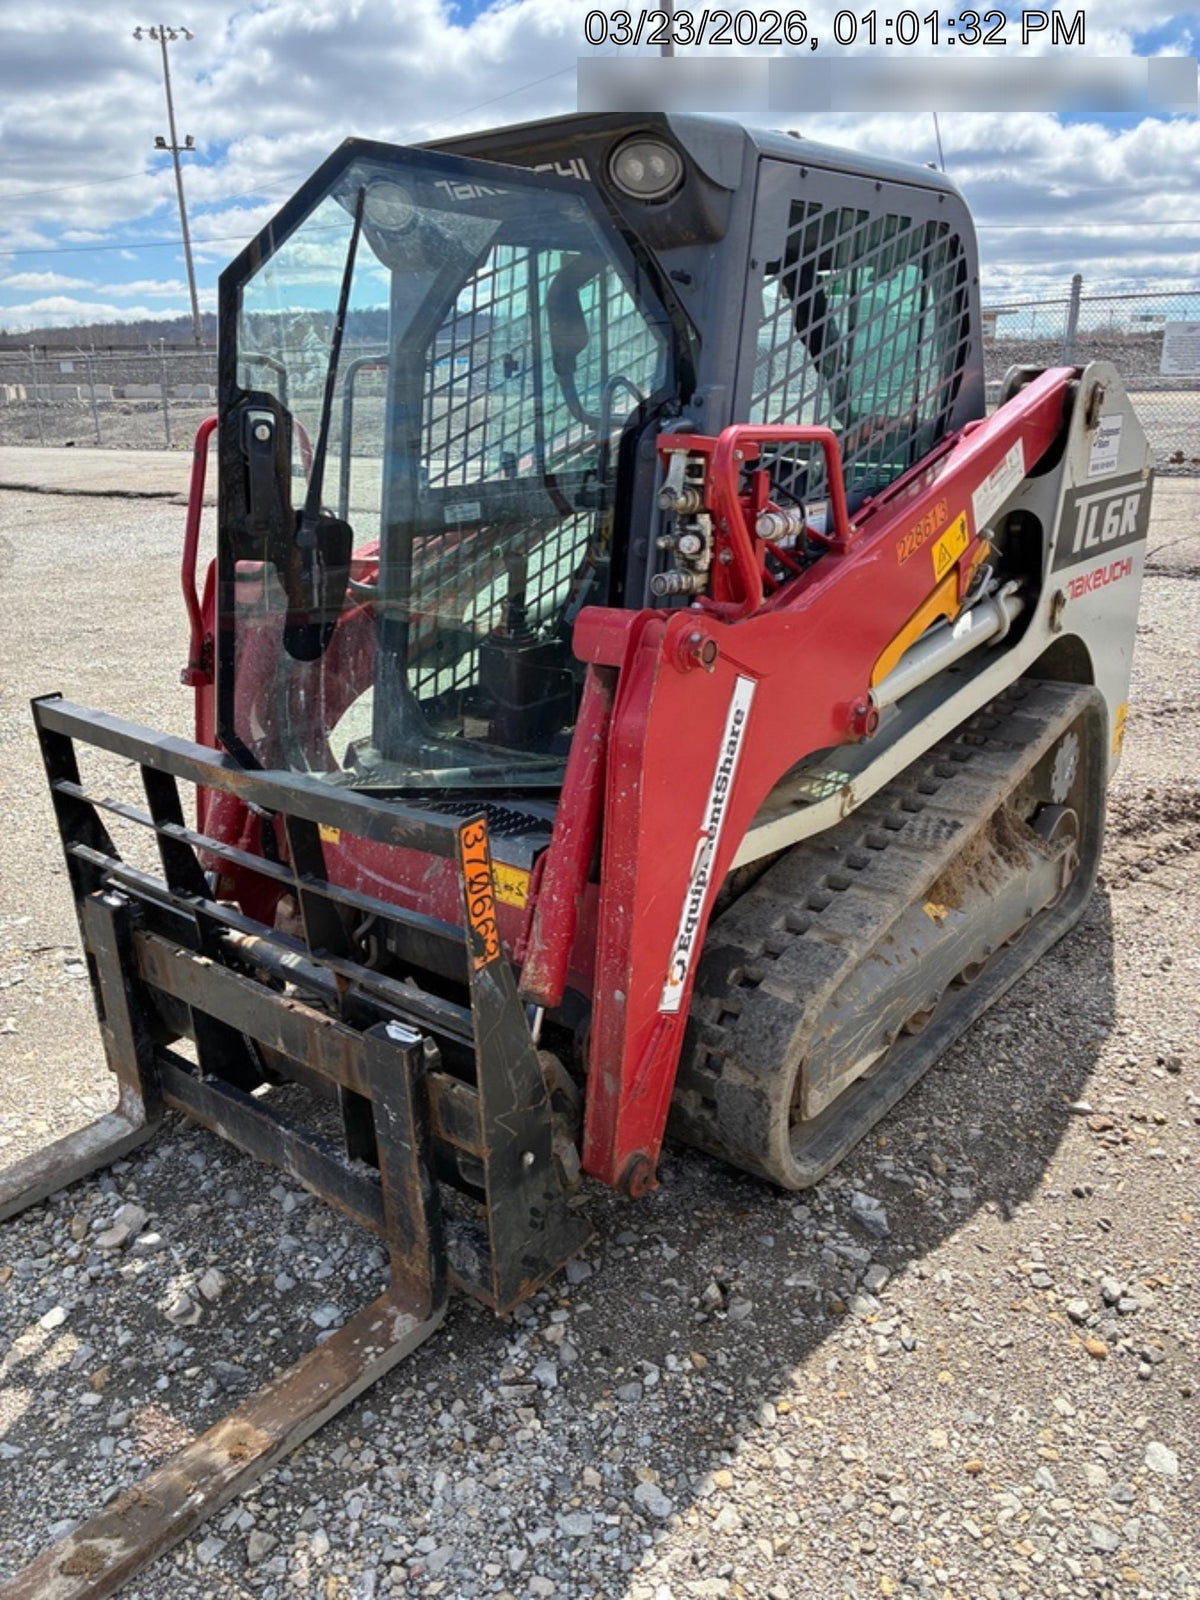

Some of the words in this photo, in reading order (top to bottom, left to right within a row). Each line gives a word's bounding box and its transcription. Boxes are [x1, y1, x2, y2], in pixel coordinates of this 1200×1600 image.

[898, 500, 949, 564] 228613
[1071, 480, 1148, 554] TL6R
[677, 708, 745, 953] EquipentShare
